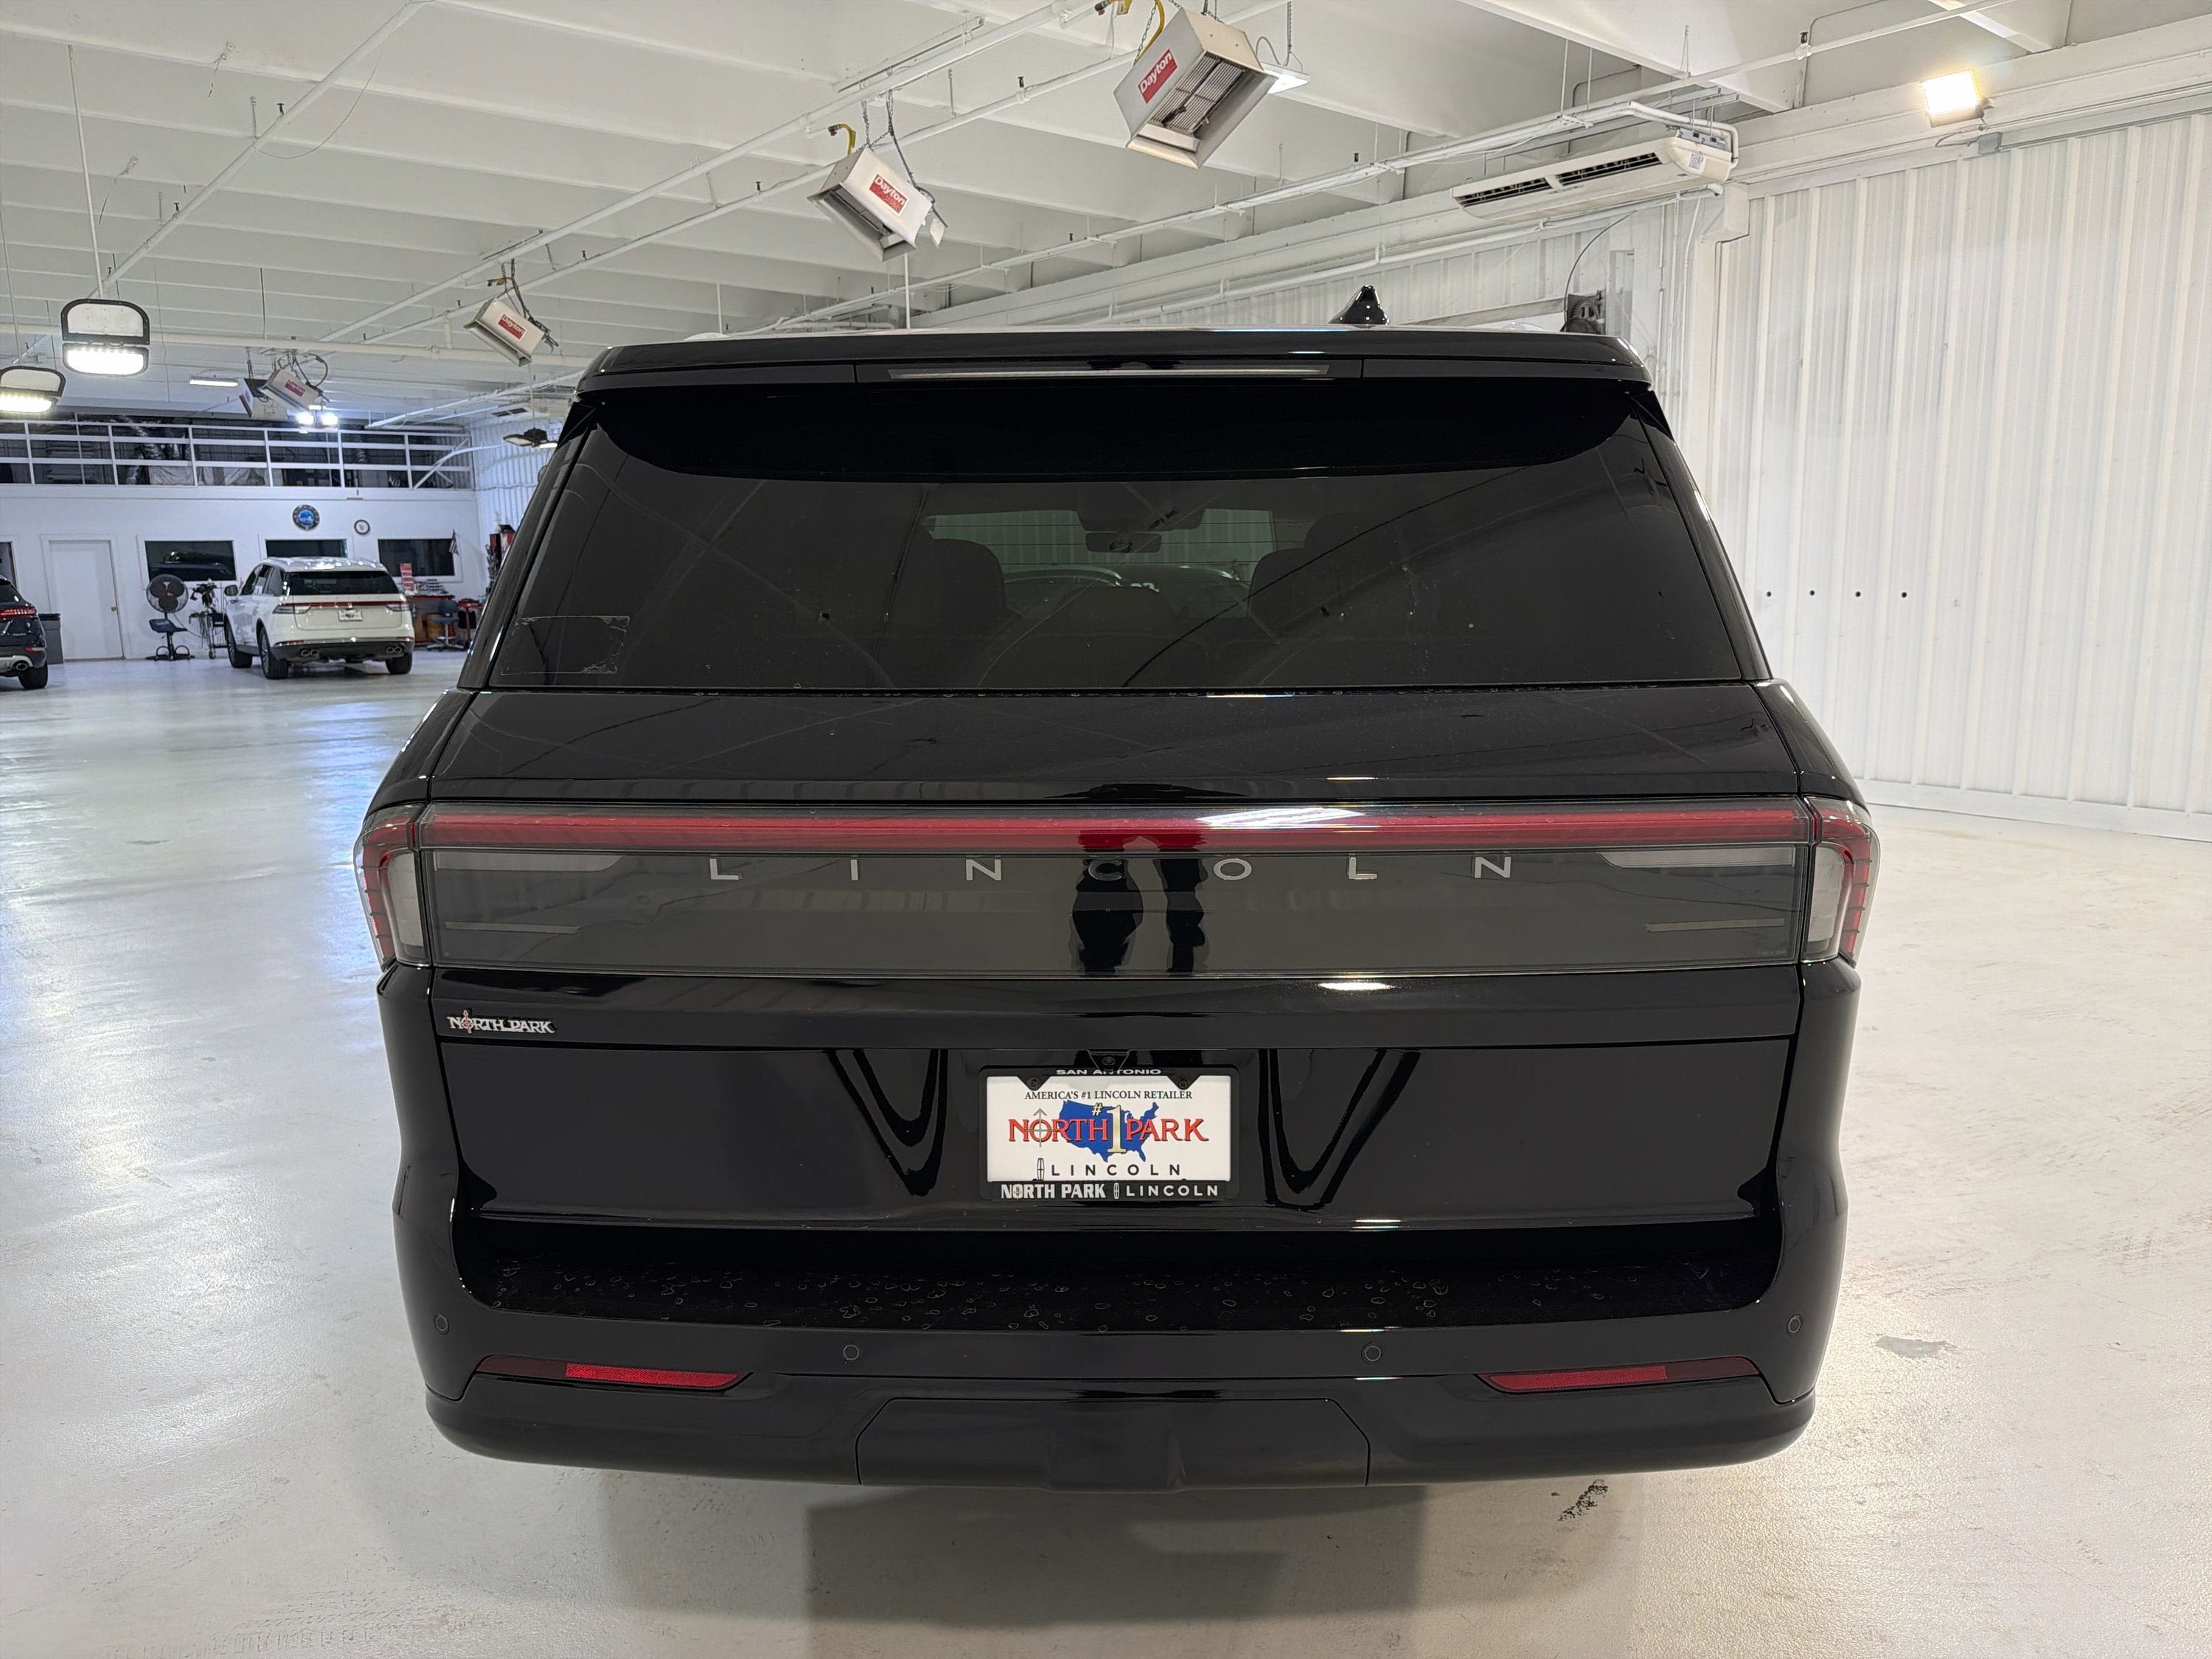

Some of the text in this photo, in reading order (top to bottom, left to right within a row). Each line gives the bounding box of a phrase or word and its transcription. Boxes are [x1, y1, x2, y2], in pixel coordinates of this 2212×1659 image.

[1139, 52, 1173, 94] Dayton
[874, 176, 905, 206] Dayton
[501, 315, 525, 335] Dayton
[709, 856, 1512, 881] LINCOLN
[447, 1015, 555, 1034] NORTH PARK
[1024, 1090, 1193, 1099] AMERICA'S #1 LINCOLN RETAILER
[1008, 1118, 1209, 1142] NORTH PARK
[1051, 1164, 1180, 1176] LINCOLN
[1001, 1183, 1218, 1199] NORTH PARK LINCOLN
